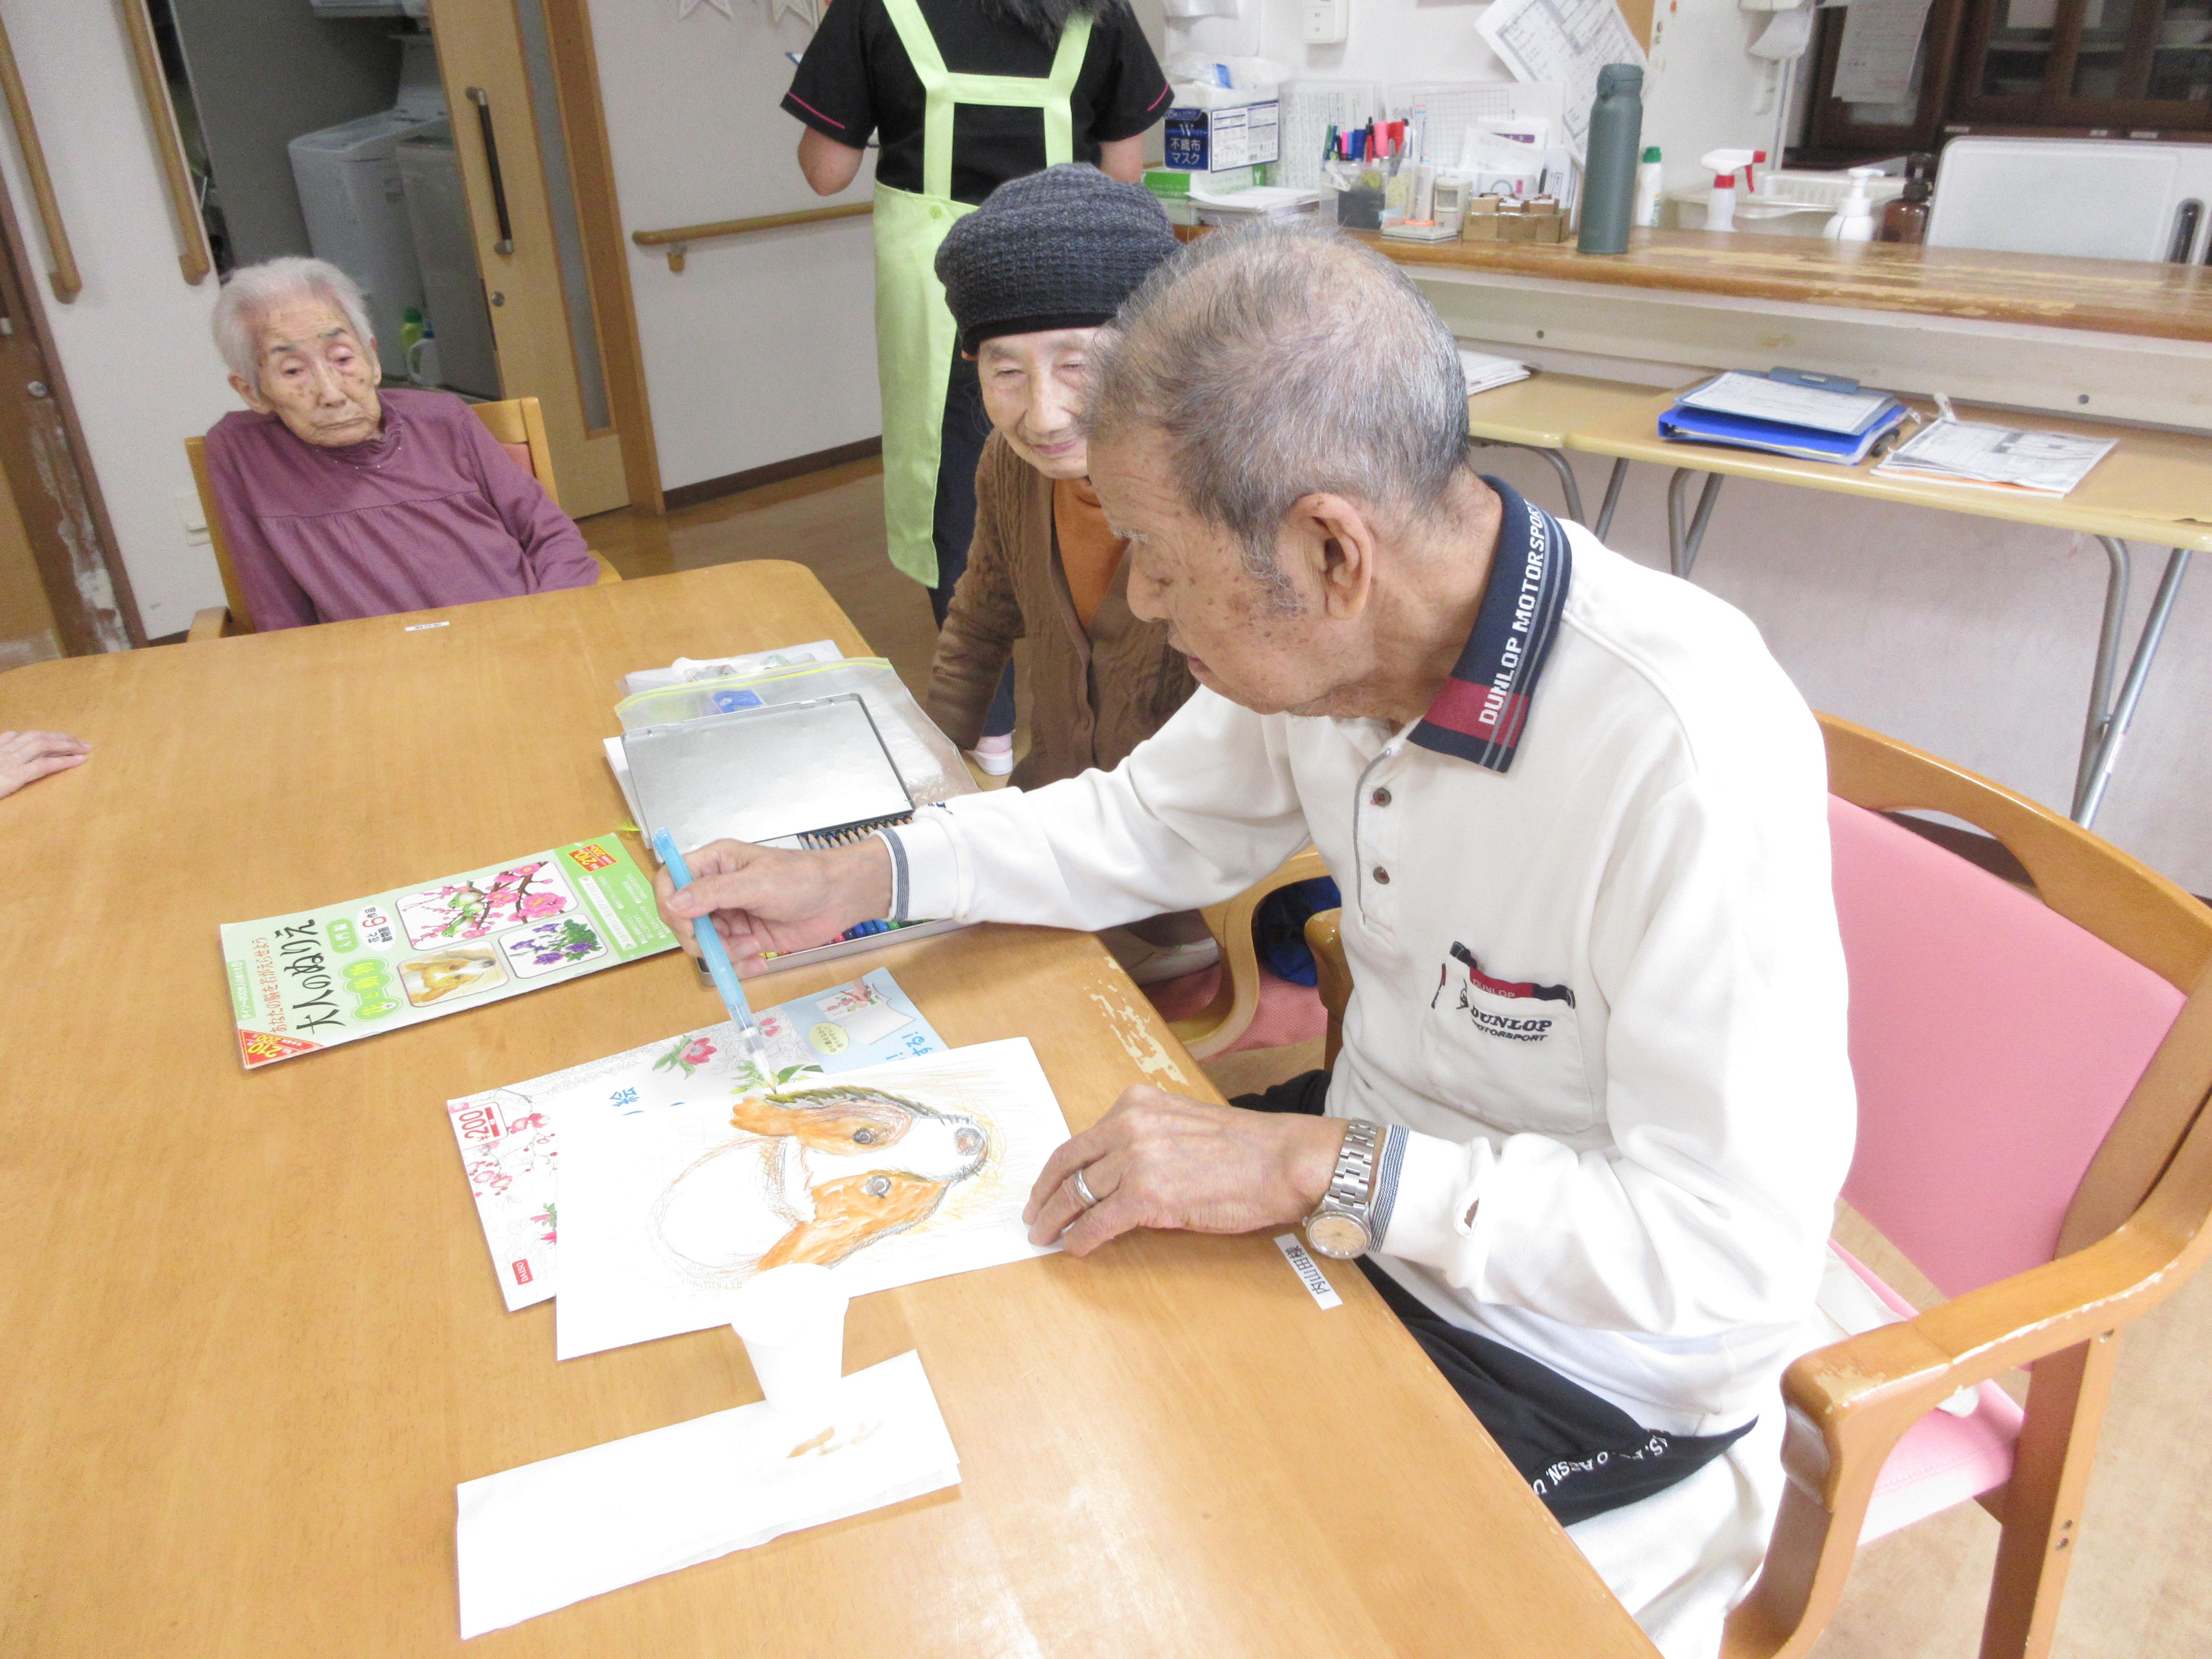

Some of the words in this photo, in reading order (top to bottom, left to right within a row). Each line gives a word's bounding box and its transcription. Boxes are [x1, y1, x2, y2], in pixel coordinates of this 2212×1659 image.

[1171, 152, 1200, 165] マスク
[1479, 637, 1524, 725] DUNLOP
[274, 919, 346, 1034] 大人のぬりえ
[350, 961, 386, 1016] 花と動物
[1473, 978, 1515, 998] DUNLOP
[1471, 1004, 1552, 1032] DUNLOP
[459, 1110, 491, 1142] ¥200
[516, 1262, 529, 1282] DAISO
